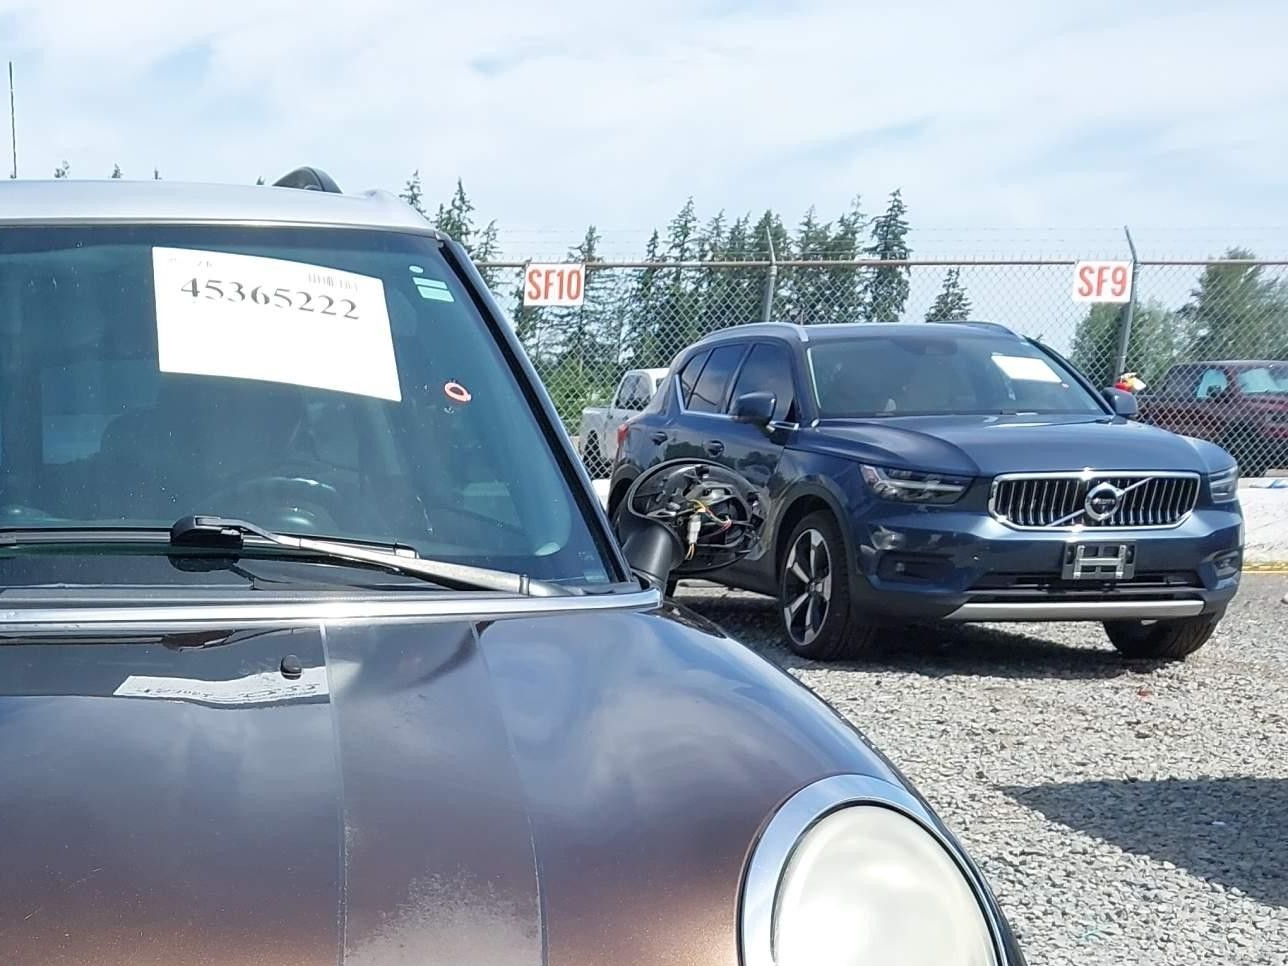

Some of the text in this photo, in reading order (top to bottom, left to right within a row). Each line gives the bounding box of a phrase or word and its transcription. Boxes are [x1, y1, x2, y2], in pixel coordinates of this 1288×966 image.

[527, 268, 582, 300] SF10
[1078, 265, 1127, 297] SF9
[180, 277, 360, 320] 45365222
